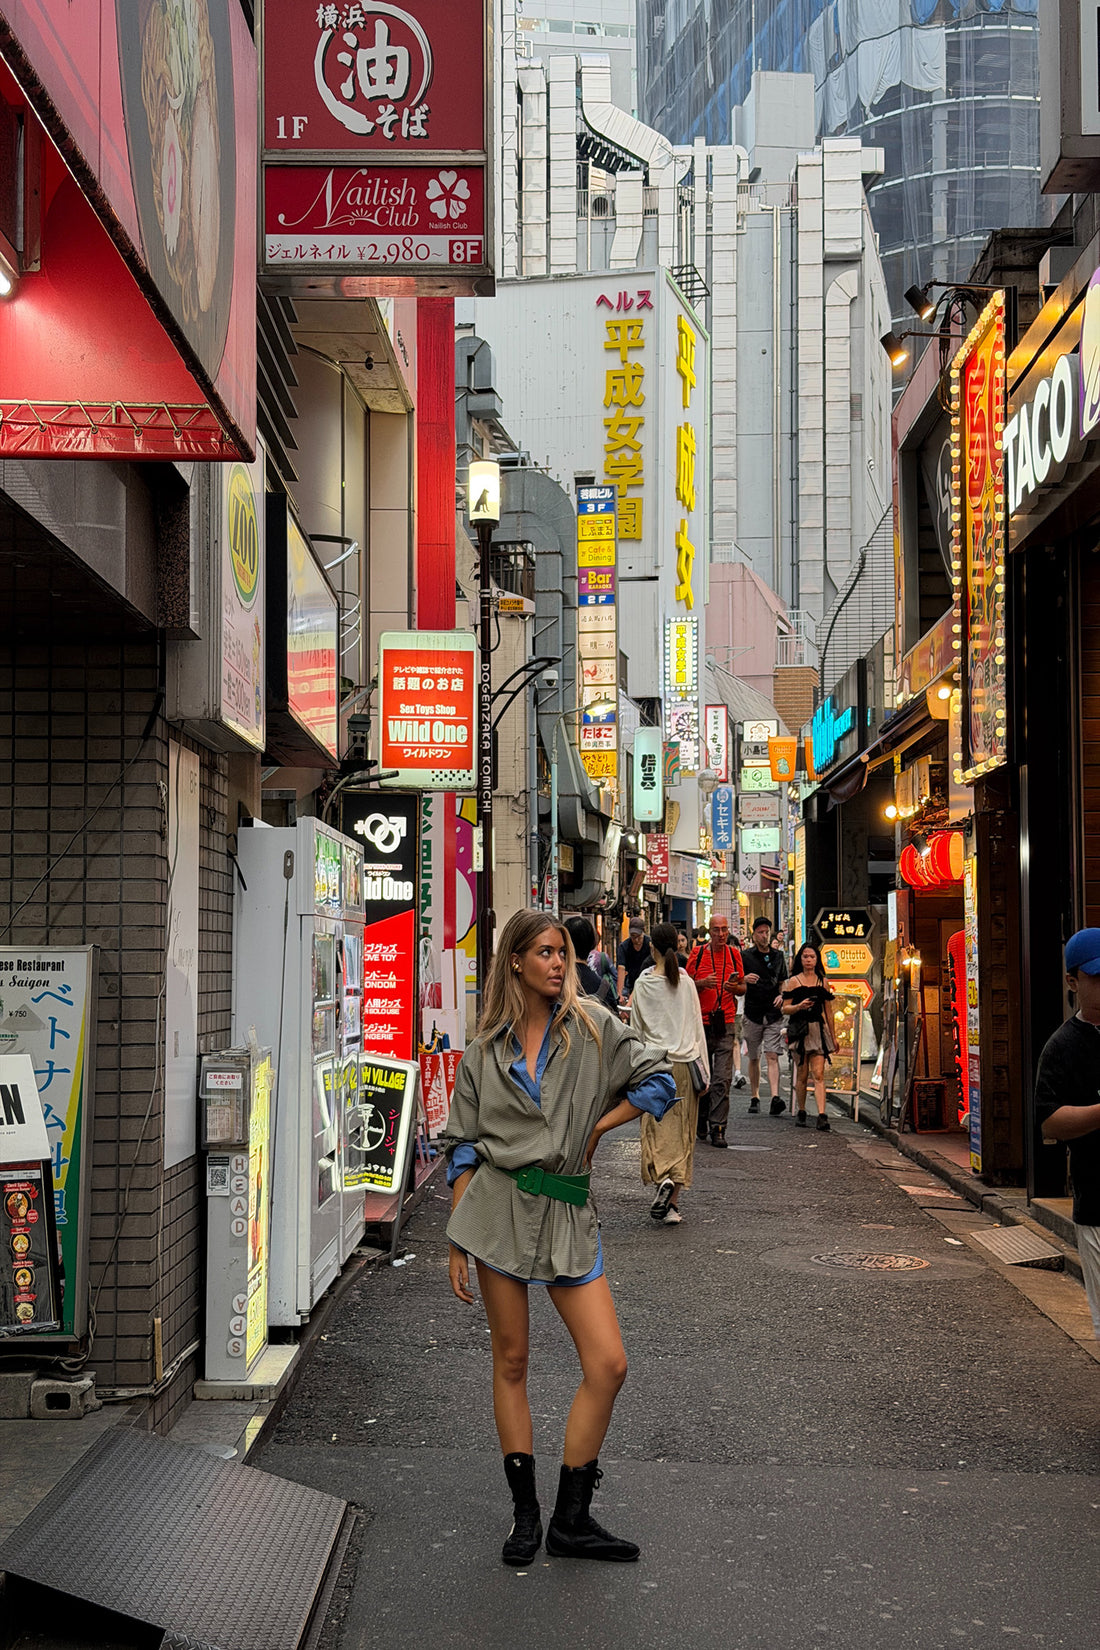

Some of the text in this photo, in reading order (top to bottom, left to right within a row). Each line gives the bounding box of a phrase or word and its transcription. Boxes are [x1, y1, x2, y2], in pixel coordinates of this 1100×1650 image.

[316, 4, 366, 29] 横浜
[337, 19, 409, 101] 油
[276, 116, 308, 138] 1F
[376, 104, 430, 138] そば
[278, 168, 417, 228] Nailish
[374, 205, 419, 227] Club
[268, 244, 350, 260] ジェルネイル
[453, 242, 480, 262] 8F
[596, 290, 654, 312] ヘルス
[1003, 355, 1072, 517] TACO
[588, 554, 612, 562] Dining
[588, 571, 612, 584] Bar
[393, 677, 464, 691] 話題のお店
[400, 704, 456, 715] Sex Toys Shop
[388, 721, 468, 743] Wild One
[583, 728, 612, 739] たばこ
[403, 749, 451, 758] ワイルドワン
[647, 840, 667, 877] たばこ
[383, 877, 413, 900] One
[17, 959, 65, 972] Restaurant
[8, 975, 50, 990] Saigon
[372, 1067, 406, 1090] VILLAGE
[384, 1108, 400, 1156] シーシャ
